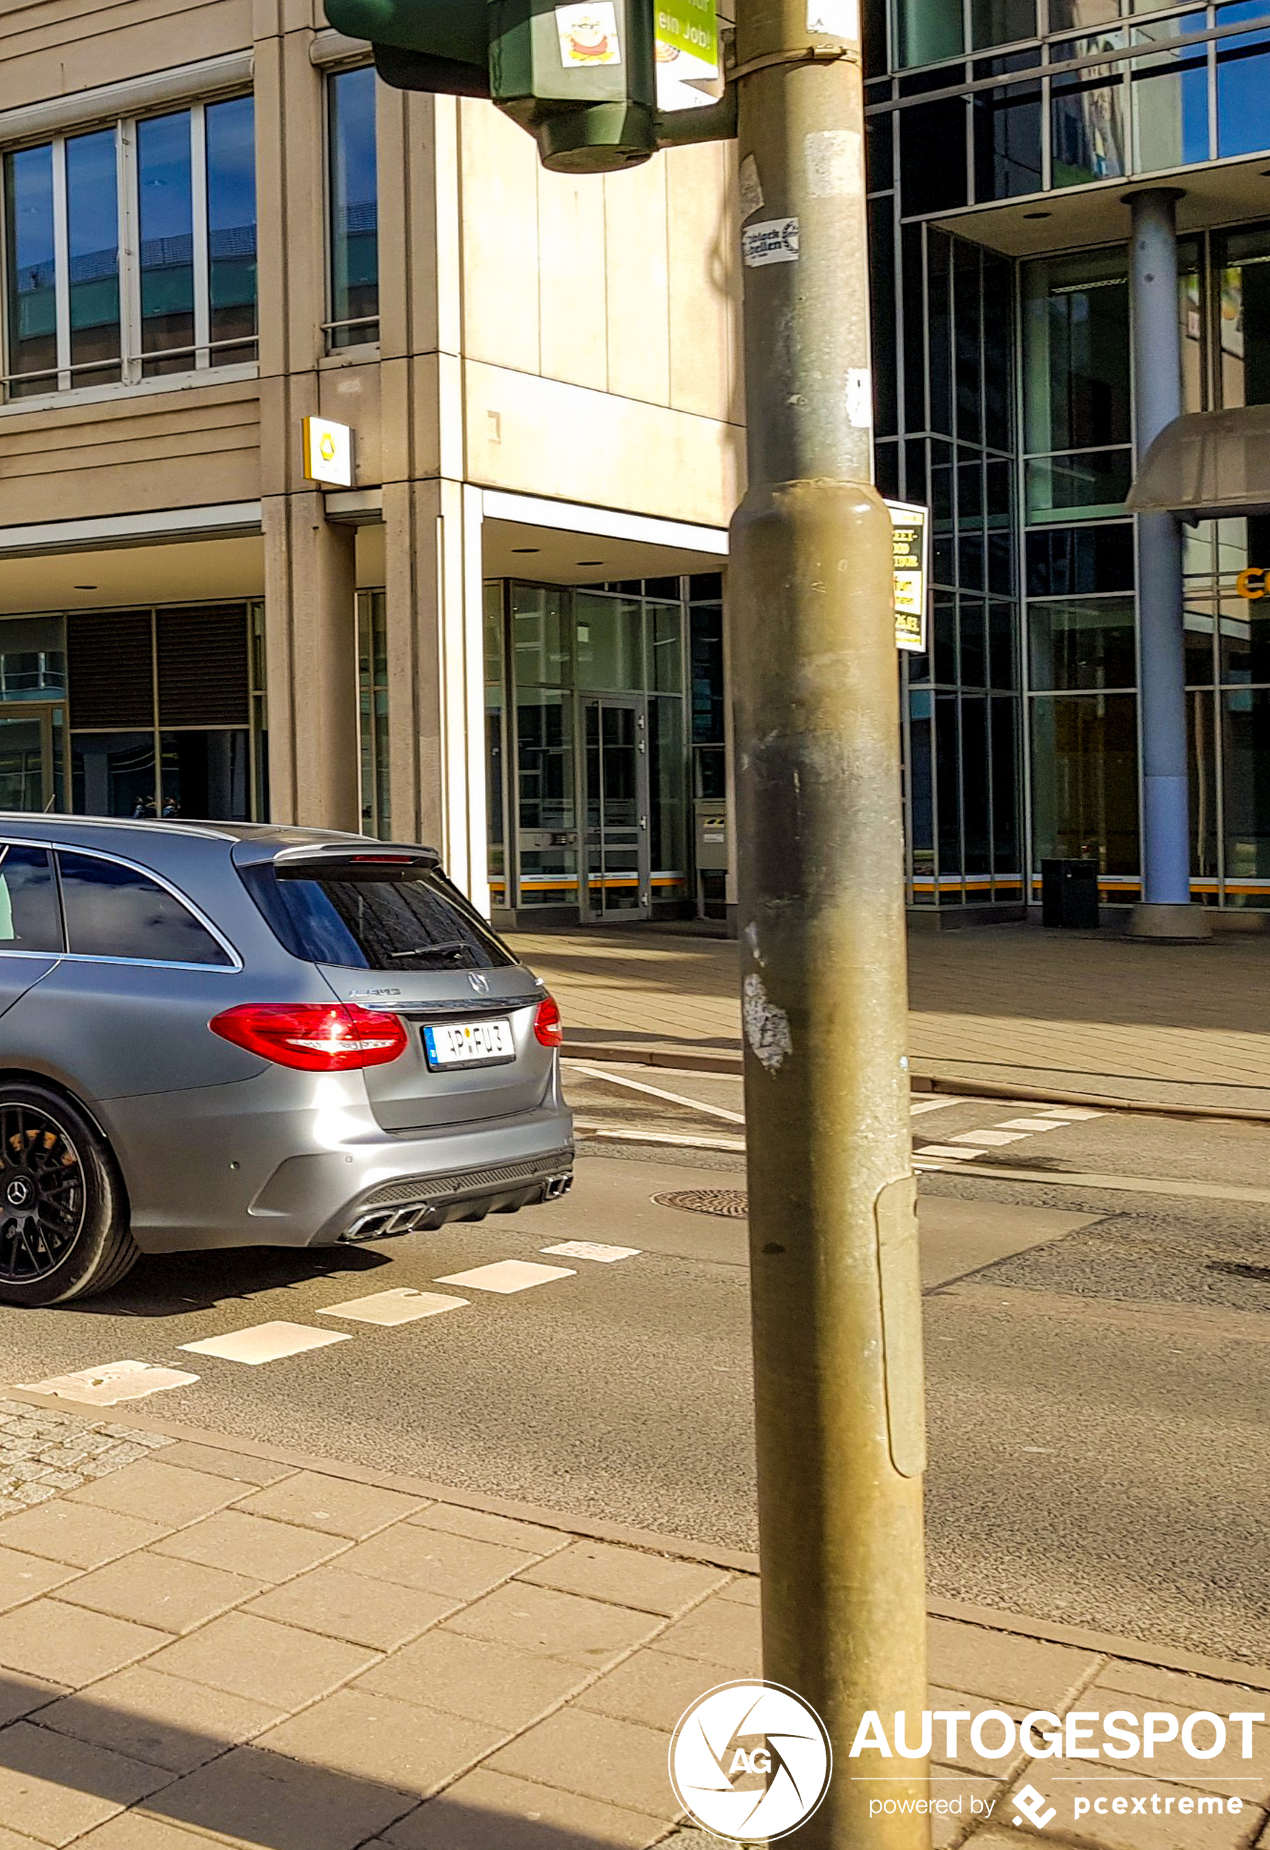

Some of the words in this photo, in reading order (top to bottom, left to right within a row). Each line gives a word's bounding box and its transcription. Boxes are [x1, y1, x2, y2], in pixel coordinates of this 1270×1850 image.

[658, 11, 679, 34] ein
[682, 24, 711, 50] Job!
[1236, 567, 1270, 599] C
